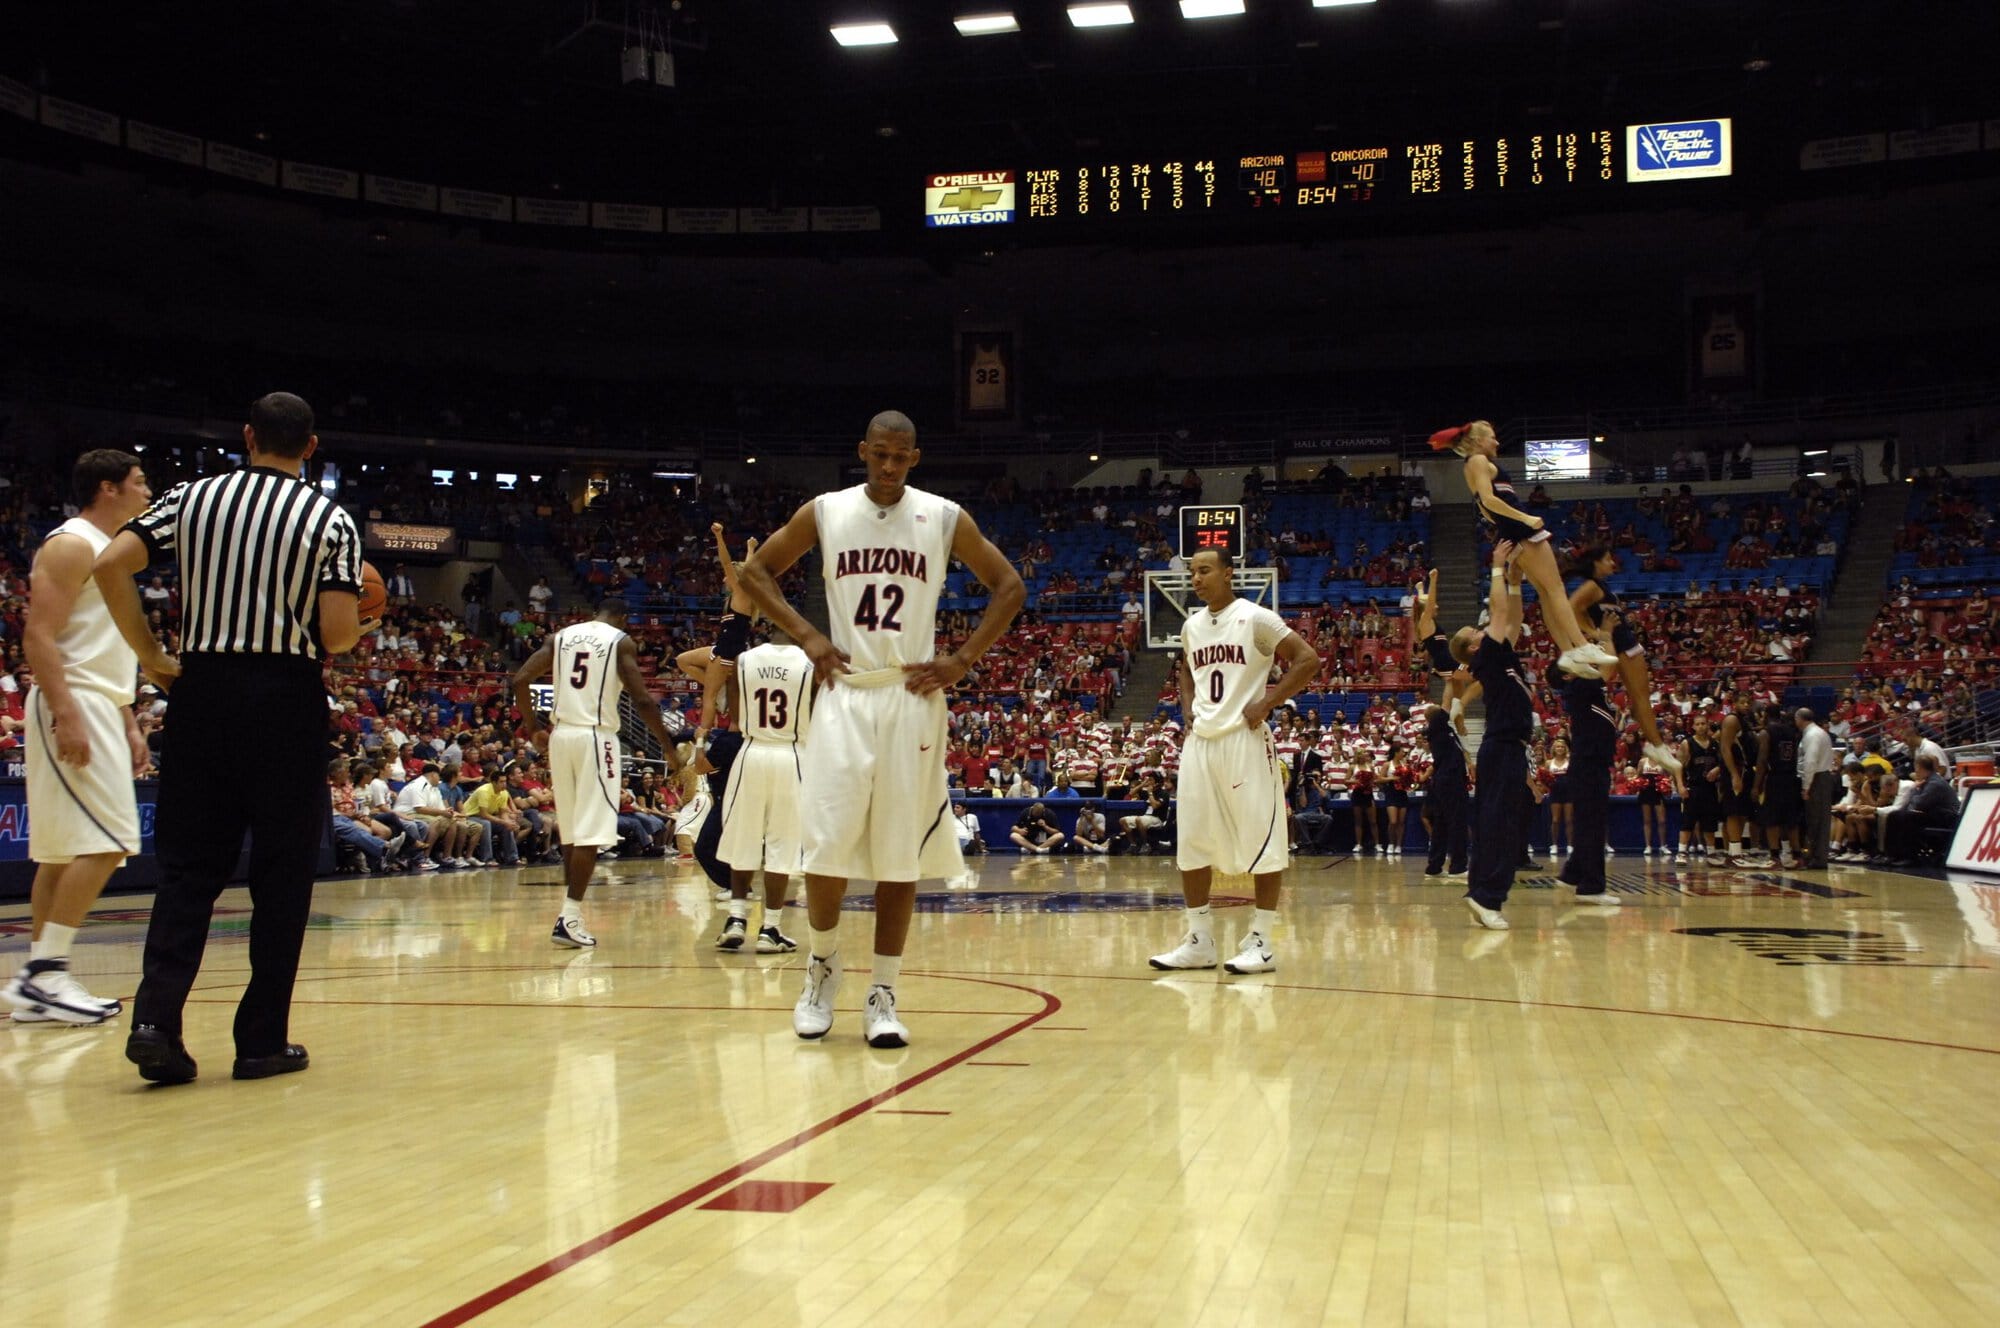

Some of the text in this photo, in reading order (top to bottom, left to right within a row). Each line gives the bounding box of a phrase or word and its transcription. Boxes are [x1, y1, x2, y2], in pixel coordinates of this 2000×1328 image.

[1406, 144, 1443, 157] PLYR
[1463, 141, 1474, 153] 5
[1497, 139, 1508, 150] 6
[1557, 133, 1577, 146] 10
[1591, 131, 1612, 143] 12
[1656, 129, 1704, 141] Tucson
[1661, 137, 1714, 151] Electric
[1240, 155, 1284, 168] ARIZONA
[1331, 148, 1388, 162] CONCORDIA
[1413, 156, 1438, 169] PTS
[1463, 154, 1474, 165] 4
[1497, 151, 1508, 163] 5
[1666, 150, 1714, 162] Power
[1026, 161, 1215, 182] PLYR 0 13 34 42 44
[1352, 163, 1375, 181] 40
[1411, 168, 1440, 181] RBS
[1463, 166, 1474, 178] 2
[1497, 163, 1508, 175] 3
[1566, 158, 1577, 170] 6
[1600, 155, 1611, 167] 4
[933, 172, 1007, 187] O'RIELLY
[1032, 172, 1215, 194] PTS 8 0 11 2 0
[1254, 170, 1276, 187] 48
[1411, 167, 1612, 193] FLS 3 1 0 1 0
[1030, 184, 1215, 205] RBS 2 0 2 3 3
[1297, 186, 1337, 205] 8:54
[1078, 202, 1089, 214] 0
[1110, 200, 1120, 213] 0
[1142, 199, 1148, 211] 1
[1172, 197, 1183, 209] 0
[1206, 195, 1212, 208] 1
[933, 211, 1008, 226] WATSON
[975, 368, 1000, 384] 32
[1294, 436, 1391, 449] HALL OF CHAMPIONS
[1198, 510, 1236, 526] 8:54
[384, 539, 438, 551] 327-7463
[836, 547, 927, 584] ARIZONA
[854, 584, 904, 633] 42
[570, 651, 590, 690] 5
[757, 666, 790, 681] WISE
[1210, 669, 1224, 704] 0
[753, 687, 788, 729] 13
[603, 741, 615, 779] CATS
